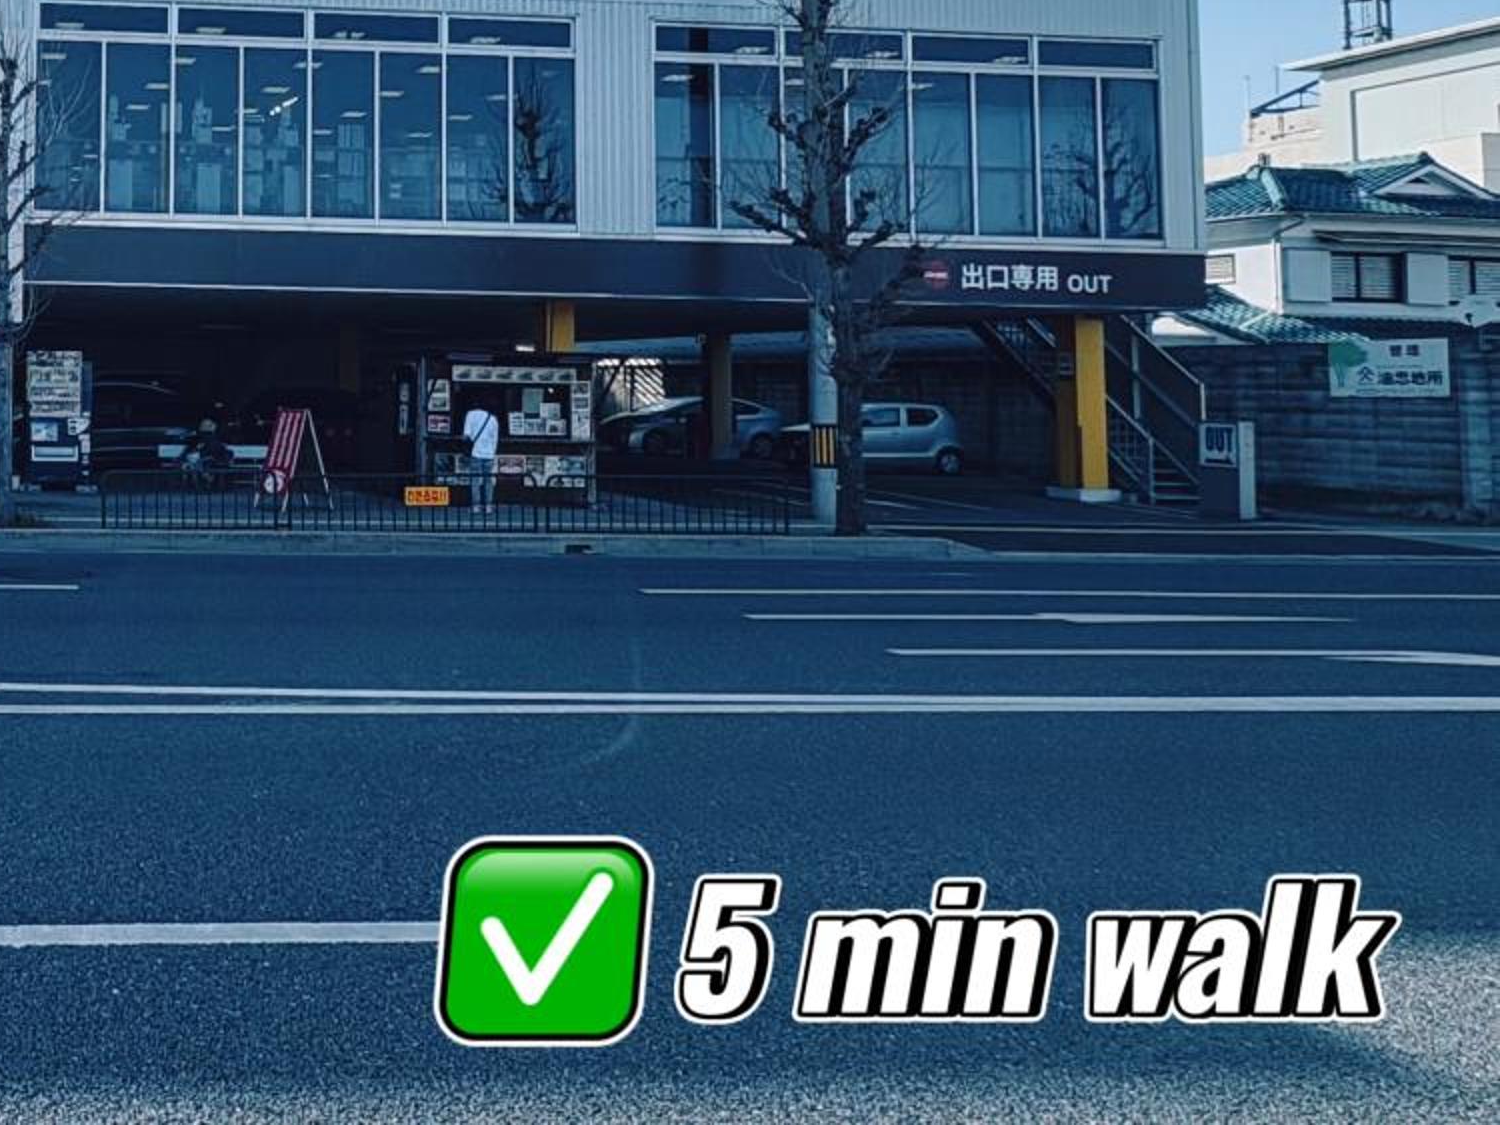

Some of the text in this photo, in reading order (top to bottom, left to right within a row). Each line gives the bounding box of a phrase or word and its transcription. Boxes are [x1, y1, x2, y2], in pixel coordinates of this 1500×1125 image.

[961, 262, 1113, 294] 出口専用 OUT
[1205, 426, 1234, 453] OUT
